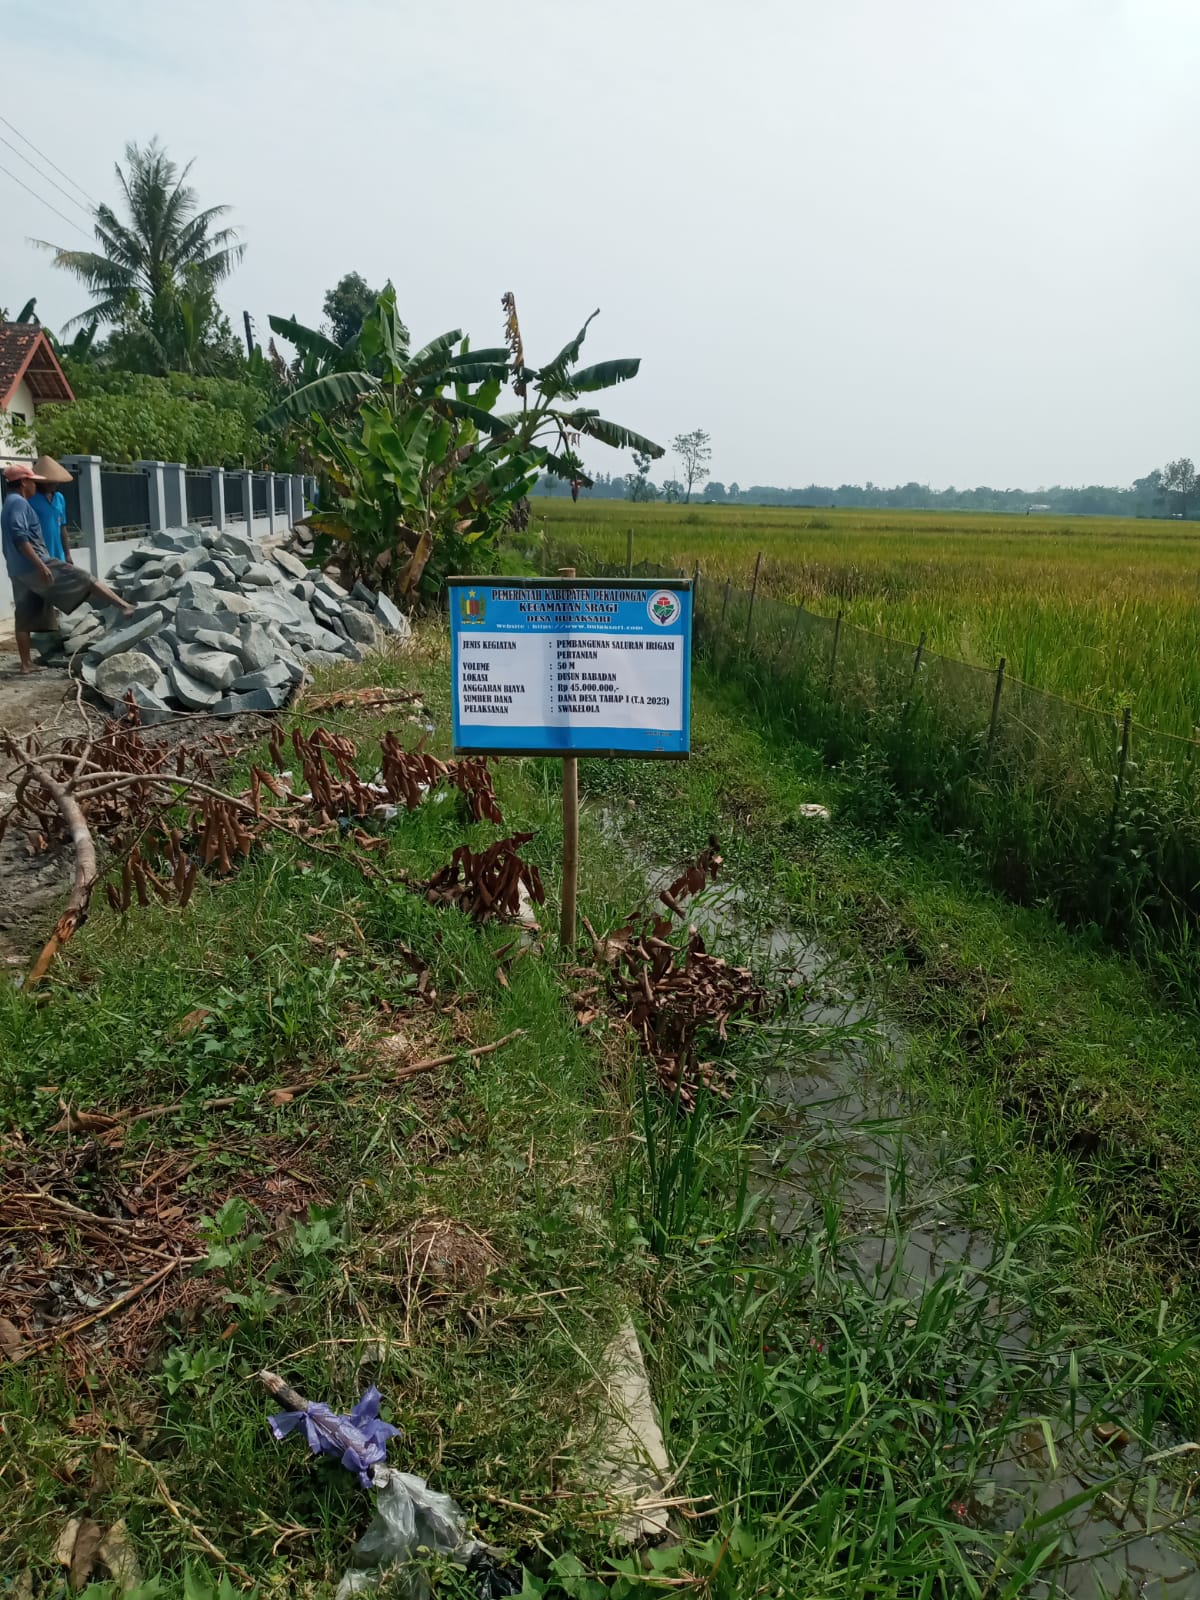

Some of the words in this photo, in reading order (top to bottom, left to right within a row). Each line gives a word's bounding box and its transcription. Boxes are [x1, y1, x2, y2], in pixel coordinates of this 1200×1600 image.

[492, 589, 541, 601] PEMERINTAH
[544, 589, 590, 602] KABUPATEN
[594, 590, 646, 602] PEKALONGAN
[519, 602, 581, 612] KECAMATAN
[584, 602, 618, 613] SRAGI
[554, 615, 610, 623] BULAKSARI
[462, 640, 480, 650] JENIS
[482, 640, 516, 650] KEGIATAN
[556, 640, 610, 649] PEMBANGUNAN
[612, 640, 644, 650] SALURAN
[646, 642, 675, 650] IRIGASI
[557, 650, 598, 660] PERTANIAN
[462, 662, 490, 671] VOLUME
[557, 662, 568, 670] 50
[568, 662, 576, 670] M
[462, 673, 488, 682] LOKASI
[557, 672, 580, 681] DUSUN
[582, 672, 617, 682] BABADAN
[462, 684, 502, 692] ANGGARAN
[504, 684, 526, 693] BIAYA
[558, 684, 568, 692] Rp
[570, 684, 620, 693] 45.000.000,-
[463, 694, 492, 703] SUMBER
[494, 695, 512, 704] DANA
[558, 694, 577, 702] DANA
[579, 694, 597, 703] DESA
[599, 694, 624, 704] TAHAP
[632, 696, 645, 704] (T.A
[646, 696, 670, 706] 2023)
[464, 704, 508, 714] PELAKSANAN
[558, 704, 600, 713] SWAKELOLA
